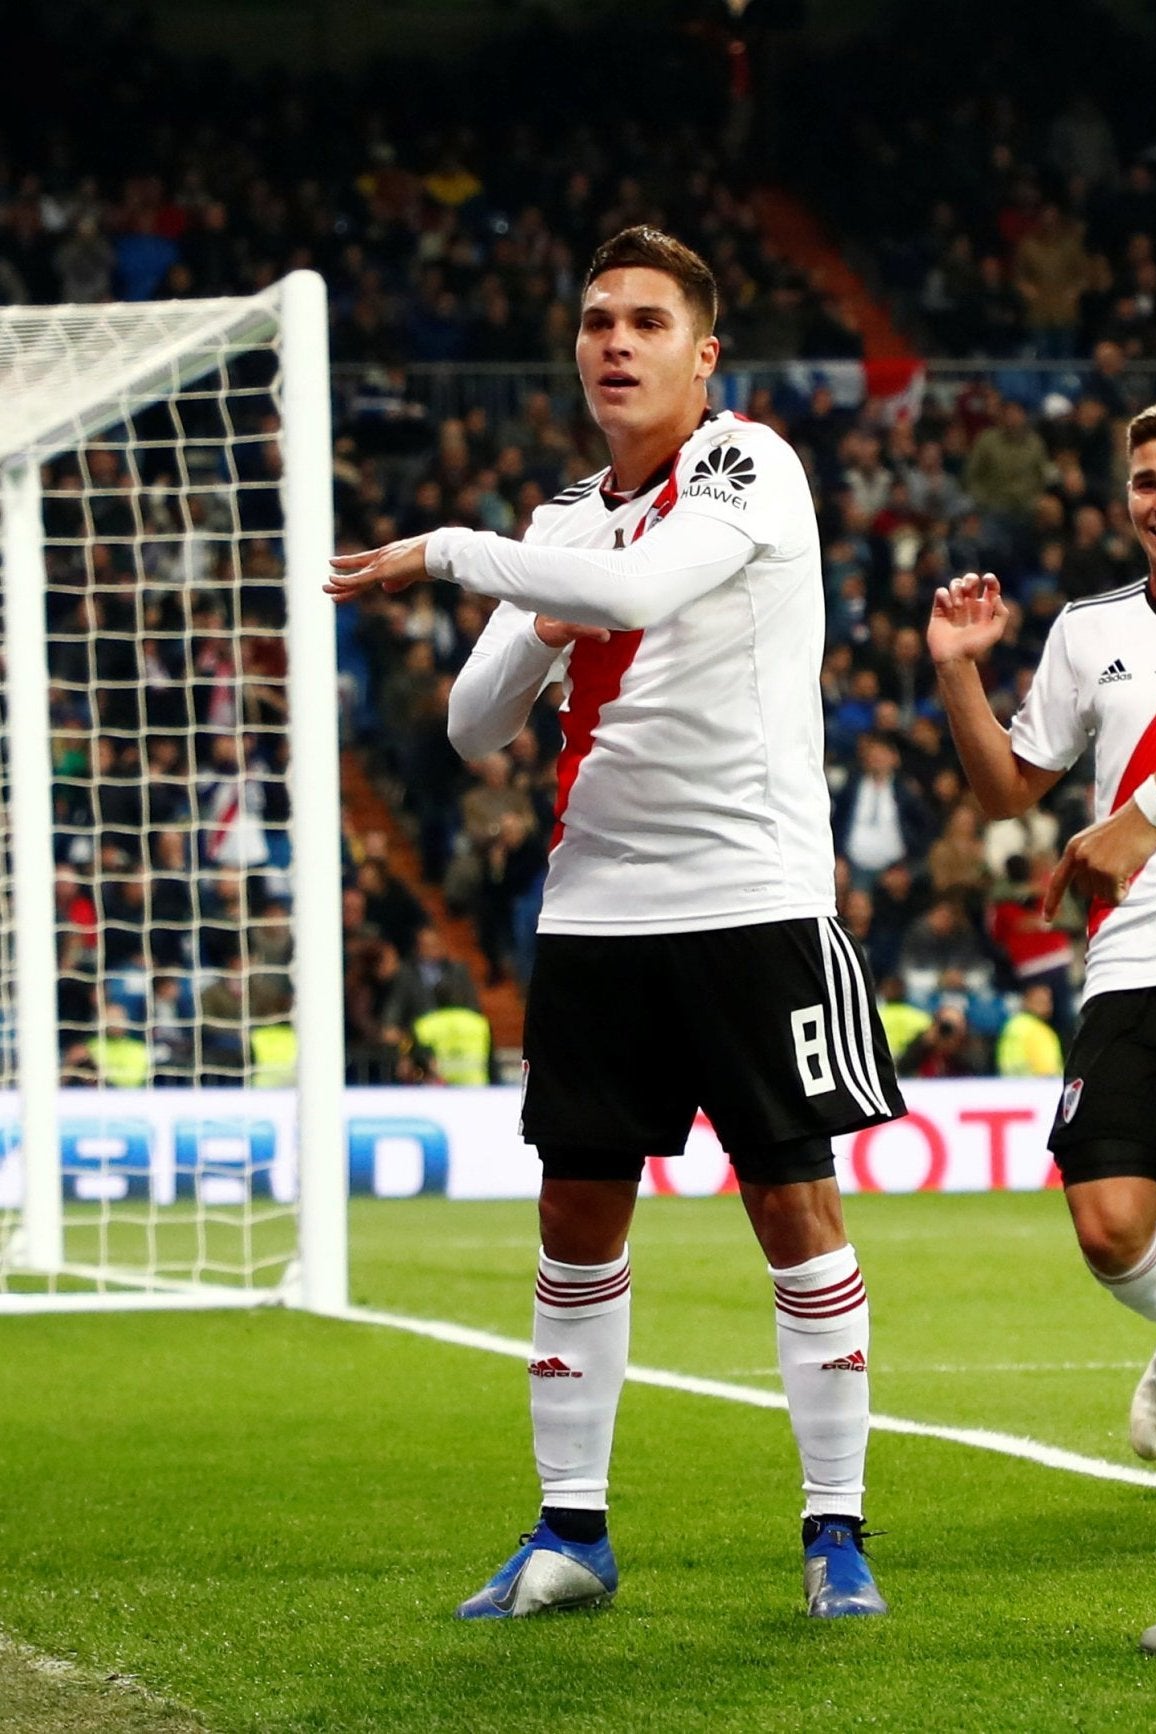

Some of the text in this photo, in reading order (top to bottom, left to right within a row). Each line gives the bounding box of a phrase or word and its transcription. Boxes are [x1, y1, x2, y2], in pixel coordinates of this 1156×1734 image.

[680, 484, 747, 511] HUAWEI
[1098, 671, 1133, 685] adidas
[790, 1003, 837, 1097] 8
